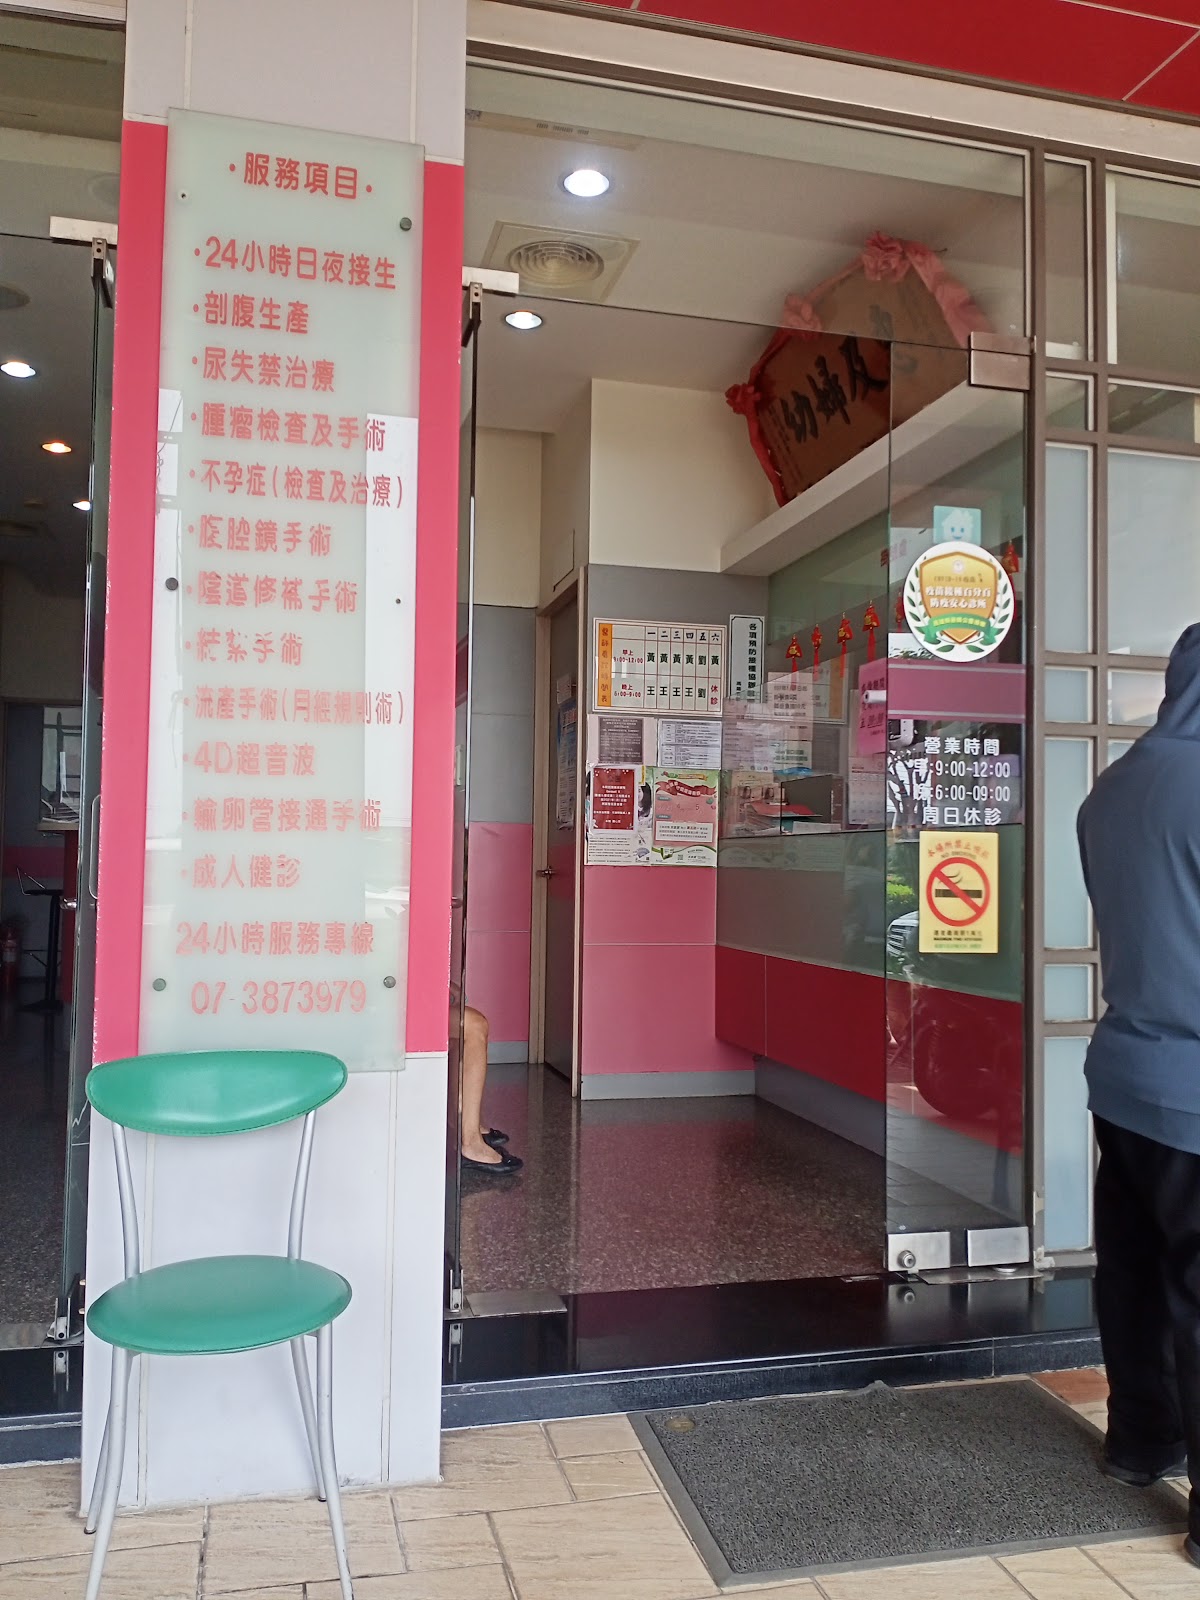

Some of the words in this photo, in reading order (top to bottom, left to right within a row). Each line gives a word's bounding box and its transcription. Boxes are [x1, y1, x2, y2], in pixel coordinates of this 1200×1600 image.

[244, 152, 358, 200] 服務項目
[205, 236, 397, 290] 24小時日夜接生
[204, 290, 309, 334] 剖腹生產
[202, 347, 335, 393] 尿失禁治療
[201, 402, 386, 452] 腫瘤檢查及手術
[201, 460, 403, 508] 不孕症(檢查及治療)
[200, 514, 331, 557] 腹腔鏡手術
[198, 570, 356, 613] 陰道修補手術
[197, 627, 303, 666] 結紮手術
[673, 631, 681, 639] 三
[699, 632, 707, 641] 五
[711, 632, 720, 641] 六
[646, 652, 656, 663] 黃
[659, 653, 669, 664] 黃
[672, 654, 682, 664] 黃
[685, 654, 694, 665] 黃
[710, 655, 720, 666] 黃
[646, 685, 656, 696] 王
[659, 686, 668, 696] 王
[672, 687, 681, 697] 王
[685, 687, 693, 698] 王
[193, 741, 316, 777] 4D超音波
[924, 736, 1000, 756] 營業時間
[194, 797, 381, 833] 輸卵管接通手術
[922, 806, 1002, 826] 周日休診
[192, 855, 301, 889] 成人健診
[176, 921, 374, 956] 24小時服務專線
[191, 980, 367, 1015] 07-3873979
